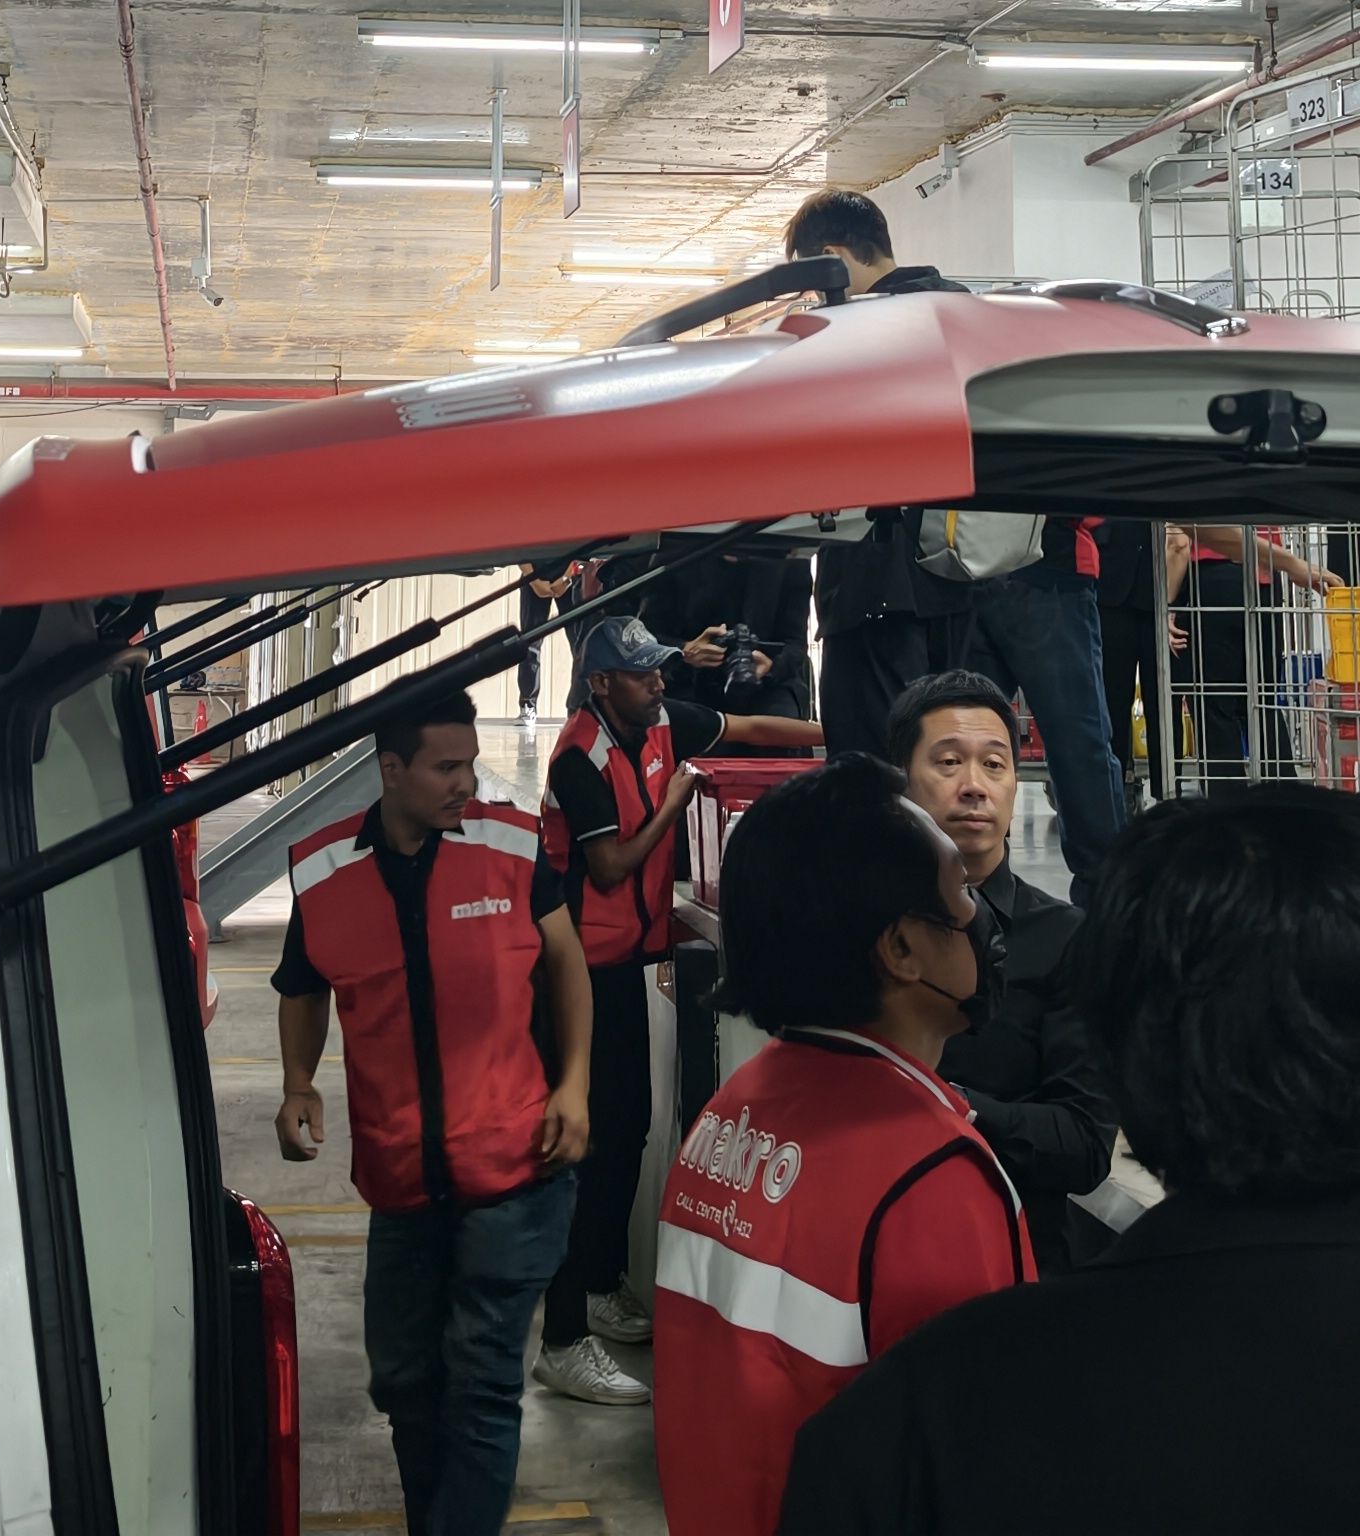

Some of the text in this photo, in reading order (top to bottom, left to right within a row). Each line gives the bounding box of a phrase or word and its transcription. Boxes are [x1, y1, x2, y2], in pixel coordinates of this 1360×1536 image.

[1299, 97, 1325, 122] 323
[1257, 172, 1293, 190] 134
[680, 1106, 802, 1203] makro
